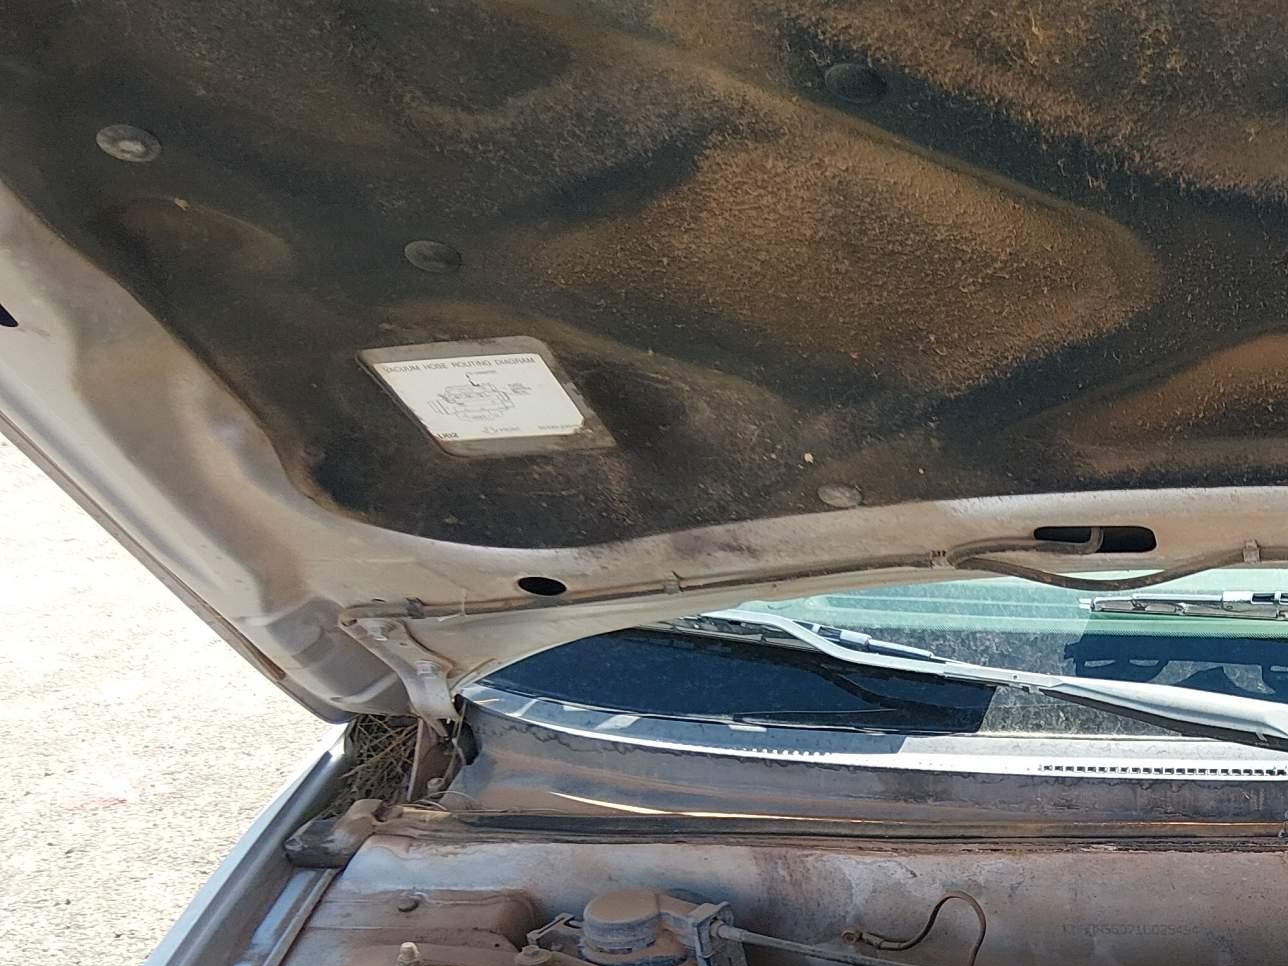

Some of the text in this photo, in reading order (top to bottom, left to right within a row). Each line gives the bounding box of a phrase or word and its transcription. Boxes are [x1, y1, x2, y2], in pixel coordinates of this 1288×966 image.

[423, 362, 448, 370] HOSE
[451, 360, 492, 368] ROUTING
[494, 357, 536, 366] DIAGRAM
